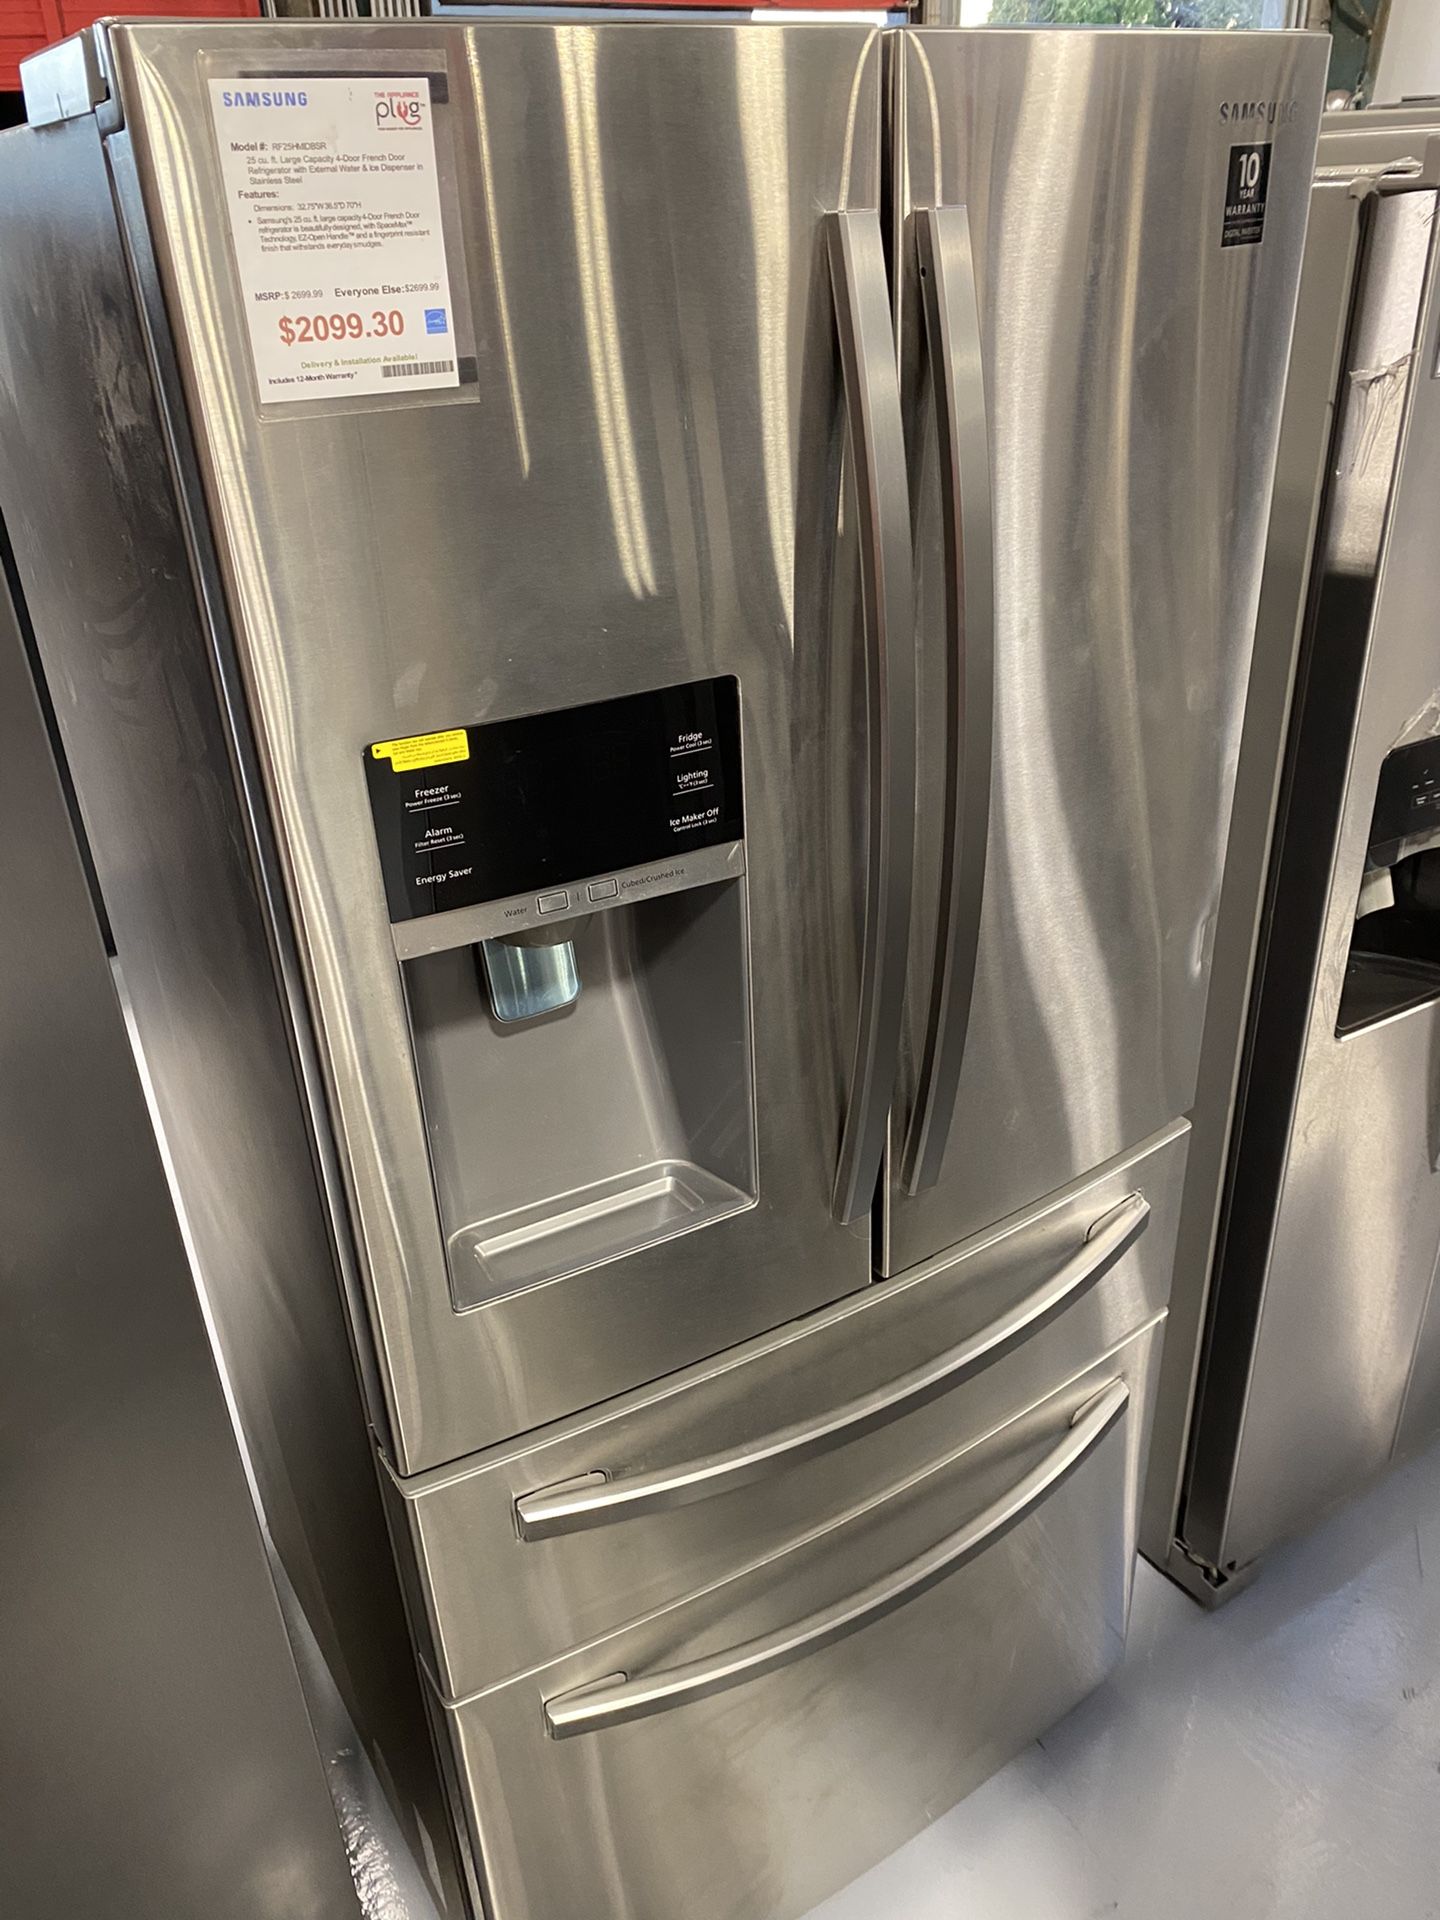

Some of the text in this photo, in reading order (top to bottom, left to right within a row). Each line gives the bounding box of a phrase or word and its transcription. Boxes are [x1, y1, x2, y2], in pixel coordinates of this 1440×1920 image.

[223, 92, 308, 107] SAMSUNG
[376, 98, 421, 126] plug
[231, 142, 258, 151] Model
[280, 155, 301, 165] Large
[303, 154, 333, 164] Capacity
[336, 154, 360, 162] 4-Door
[362, 153, 387, 161] French
[388, 153, 405, 161] Door
[248, 165, 291, 175] Refrigerator
[293, 165, 307, 173] with
[309, 163, 337, 173] External
[339, 163, 360, 172] Water
[381, 162, 415, 171] Dispenser
[1240, 152, 1260, 188] 10
[249, 176, 303, 185] Stainless Steel
[238, 190, 279, 199] Features:
[1240, 188, 1255, 199] YEAR
[1226, 202, 1265, 217] WARRANTY
[291, 289, 323, 299] 2699.99
[334, 287, 379, 297] Everyone
[279, 310, 404, 347] $2099.30
[301, 360, 332, 369] Delivery
[341, 356, 381, 366] Installation
[268, 377, 295, 385] Includes
[297, 374, 325, 382] 12-Month
[679, 732, 703, 743] Fridge
[677, 769, 709, 783] Lighting
[415, 785, 449, 799] Freezer
[405, 800, 423, 808] Power
[669, 806, 719, 827] Ice Maker Off
[425, 826, 453, 838] Alarm
[430, 837, 446, 845] Reset
[416, 866, 473, 886] Energy Saver
[504, 906, 527, 919] Water
